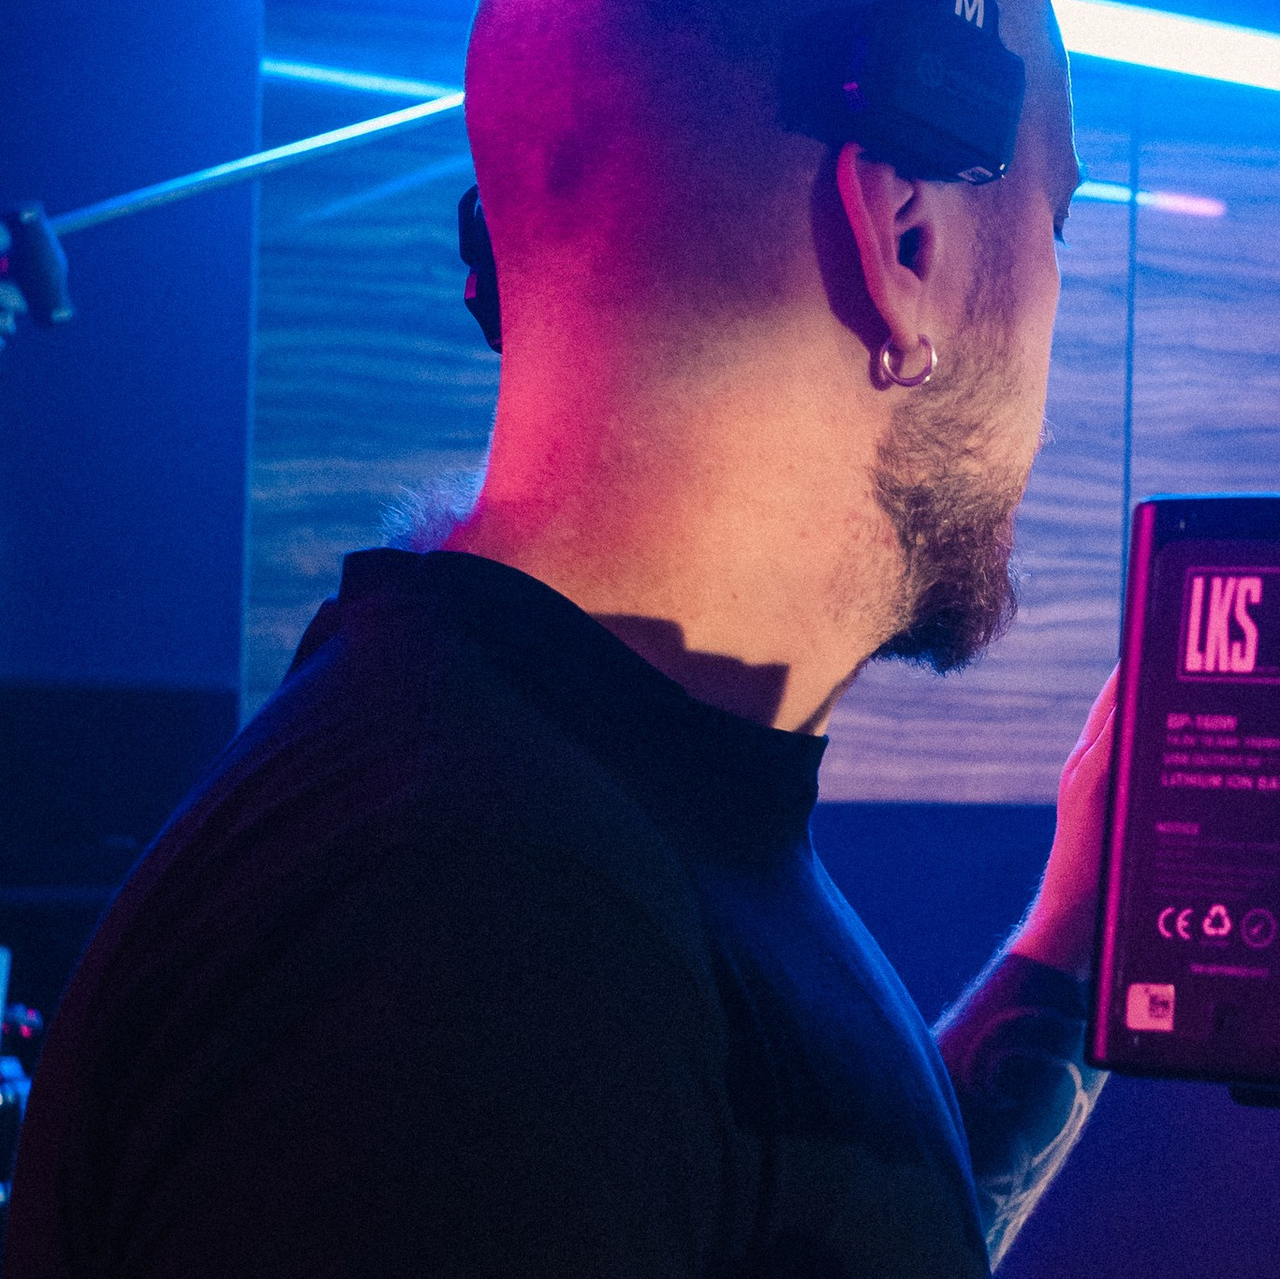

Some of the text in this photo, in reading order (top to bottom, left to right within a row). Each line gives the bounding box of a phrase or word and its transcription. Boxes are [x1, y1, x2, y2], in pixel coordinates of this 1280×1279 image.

[1185, 576, 1263, 674] LKS
[1161, 772, 1223, 789] LITHIUM
[1225, 774, 1254, 790] ION
